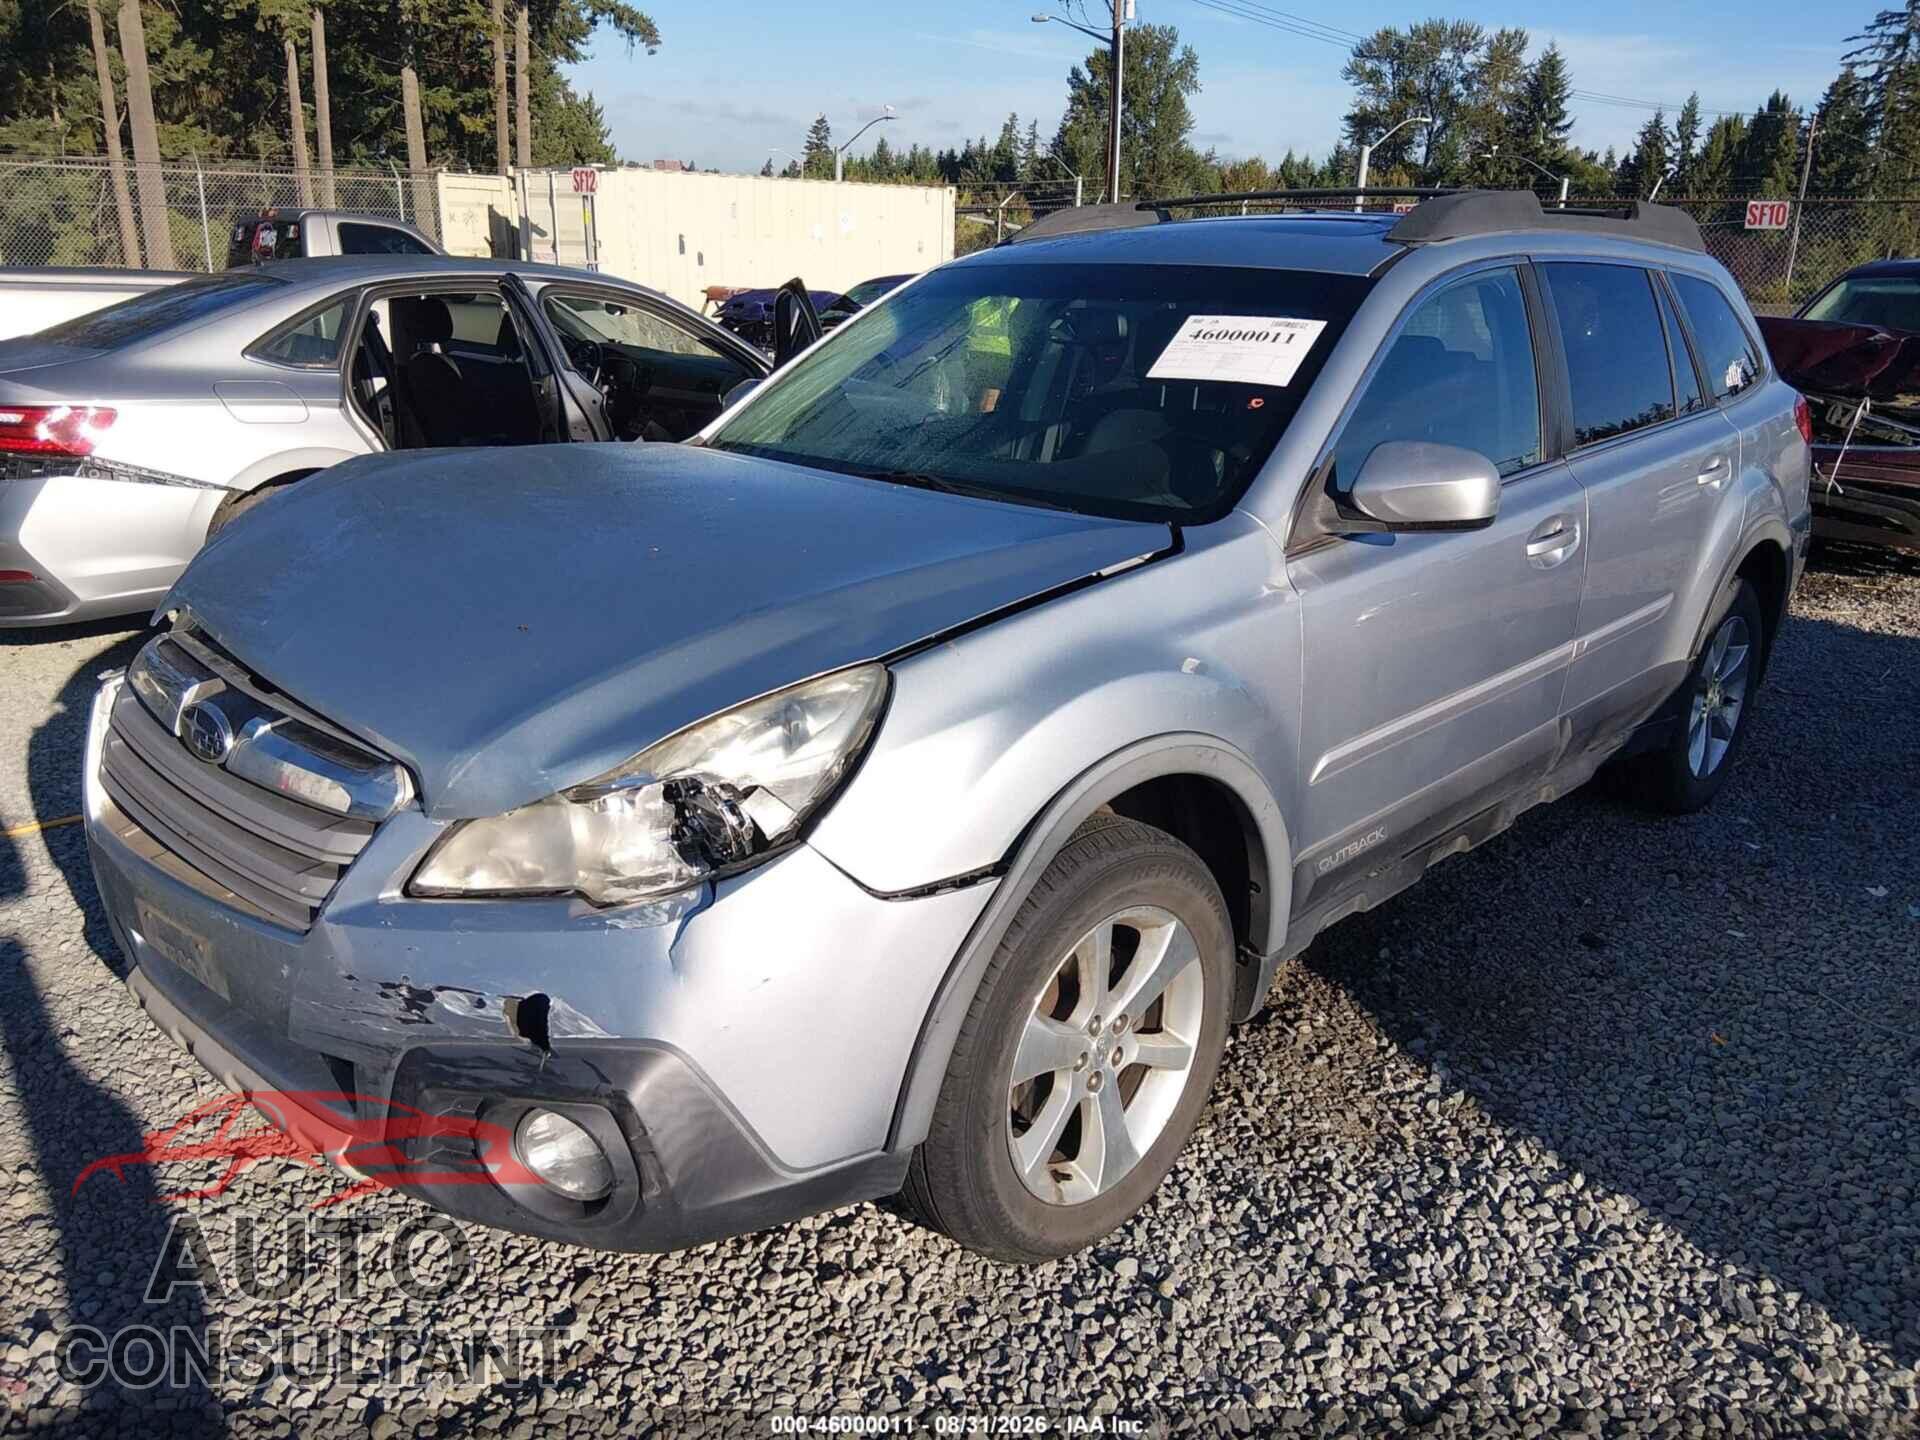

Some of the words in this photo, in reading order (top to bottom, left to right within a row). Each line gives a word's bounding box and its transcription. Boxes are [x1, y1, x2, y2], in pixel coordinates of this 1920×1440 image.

[573, 170, 596, 193] SF12
[1747, 203, 1787, 226] SF10
[1188, 328, 1297, 344] 46000011
[1318, 826, 1386, 872] OUTBACK
